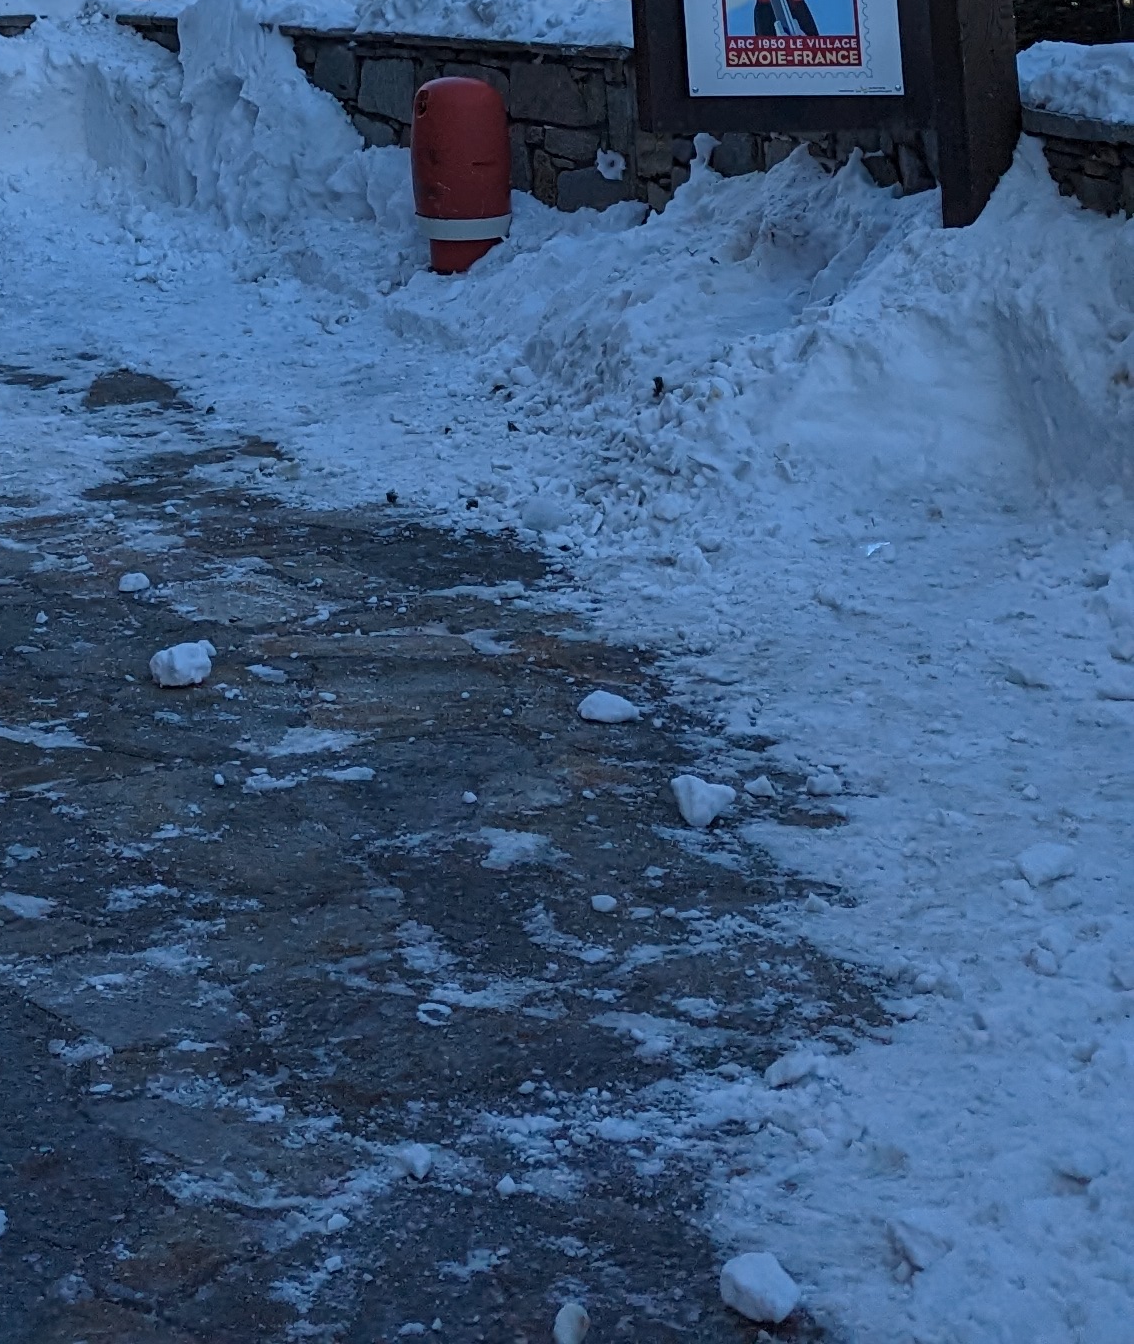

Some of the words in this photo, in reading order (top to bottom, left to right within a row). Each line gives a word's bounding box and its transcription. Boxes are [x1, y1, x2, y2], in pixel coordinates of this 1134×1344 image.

[728, 38, 754, 49] ARC
[758, 38, 786, 49] 1950
[789, 38, 804, 49] LE
[806, 38, 858, 49] VILLAGE
[728, 50, 859, 65] SAVOIE-FRANCE
